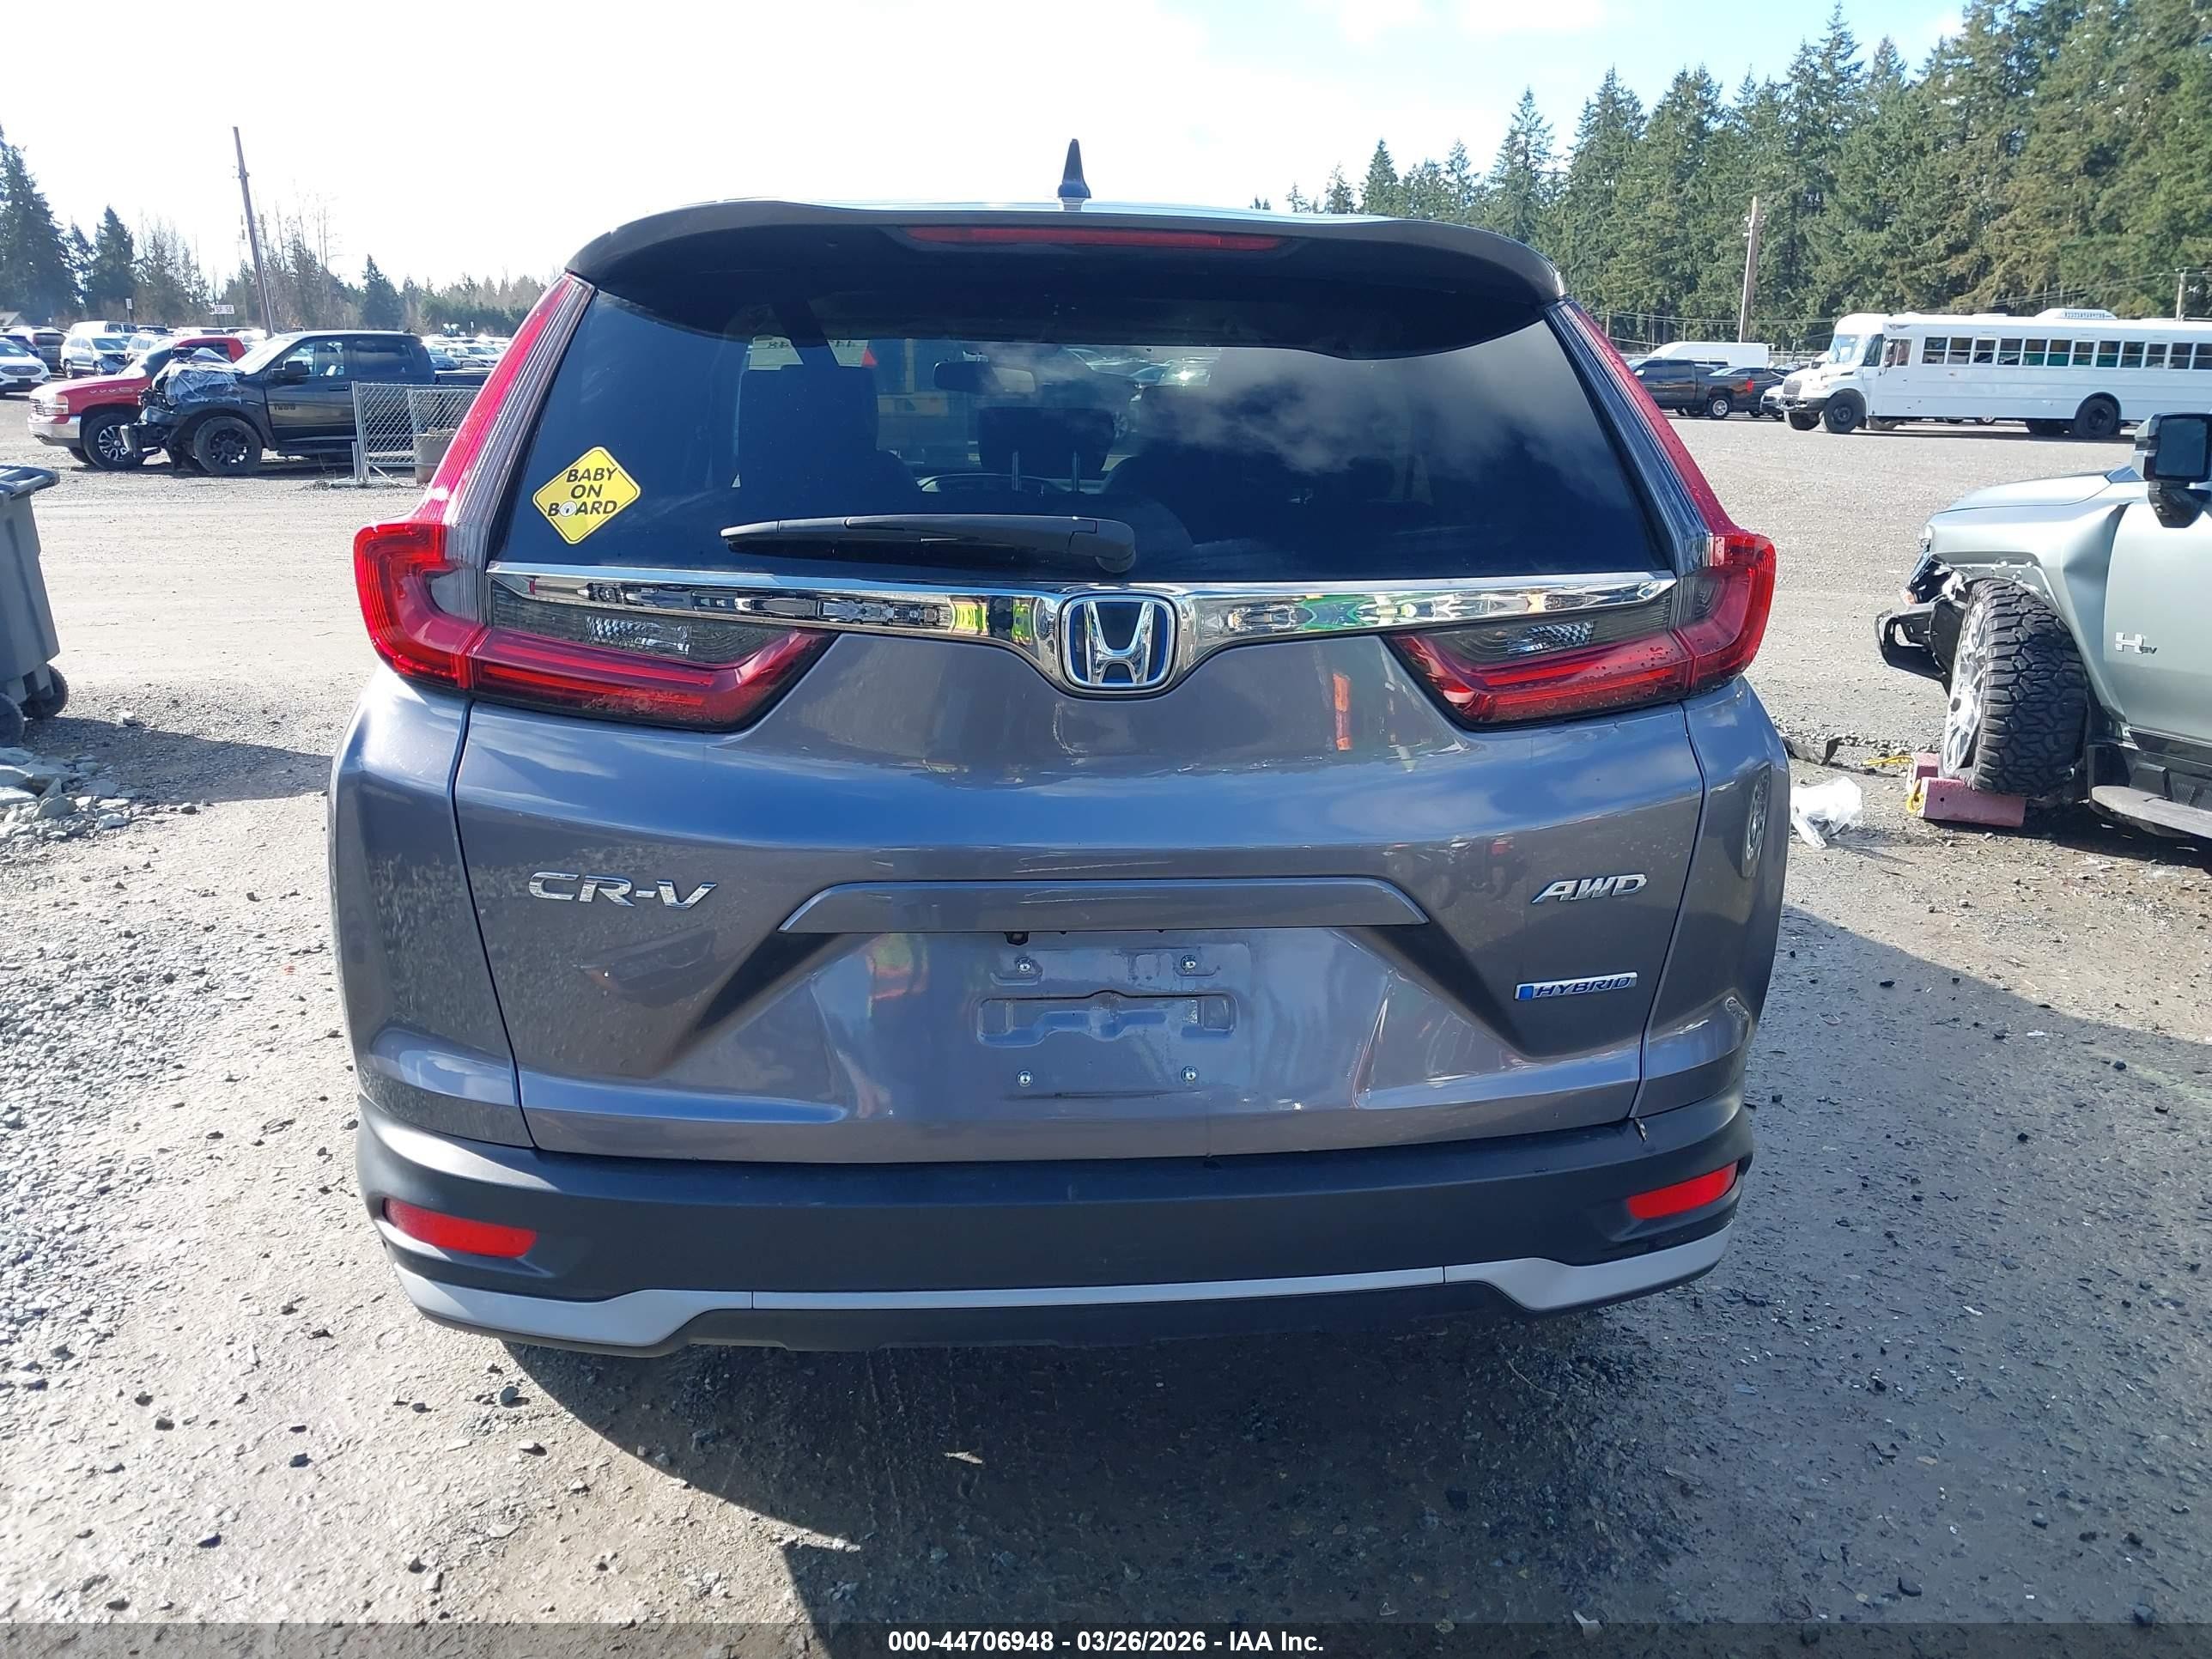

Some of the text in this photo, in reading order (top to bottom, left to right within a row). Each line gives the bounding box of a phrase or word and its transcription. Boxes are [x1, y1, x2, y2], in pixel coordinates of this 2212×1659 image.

[566, 466, 618, 483] BABY
[570, 484, 603, 499] ON
[528, 871, 718, 910] CR-V
[1531, 873, 1648, 903] AWD
[1535, 976, 1633, 999] HYBRID
